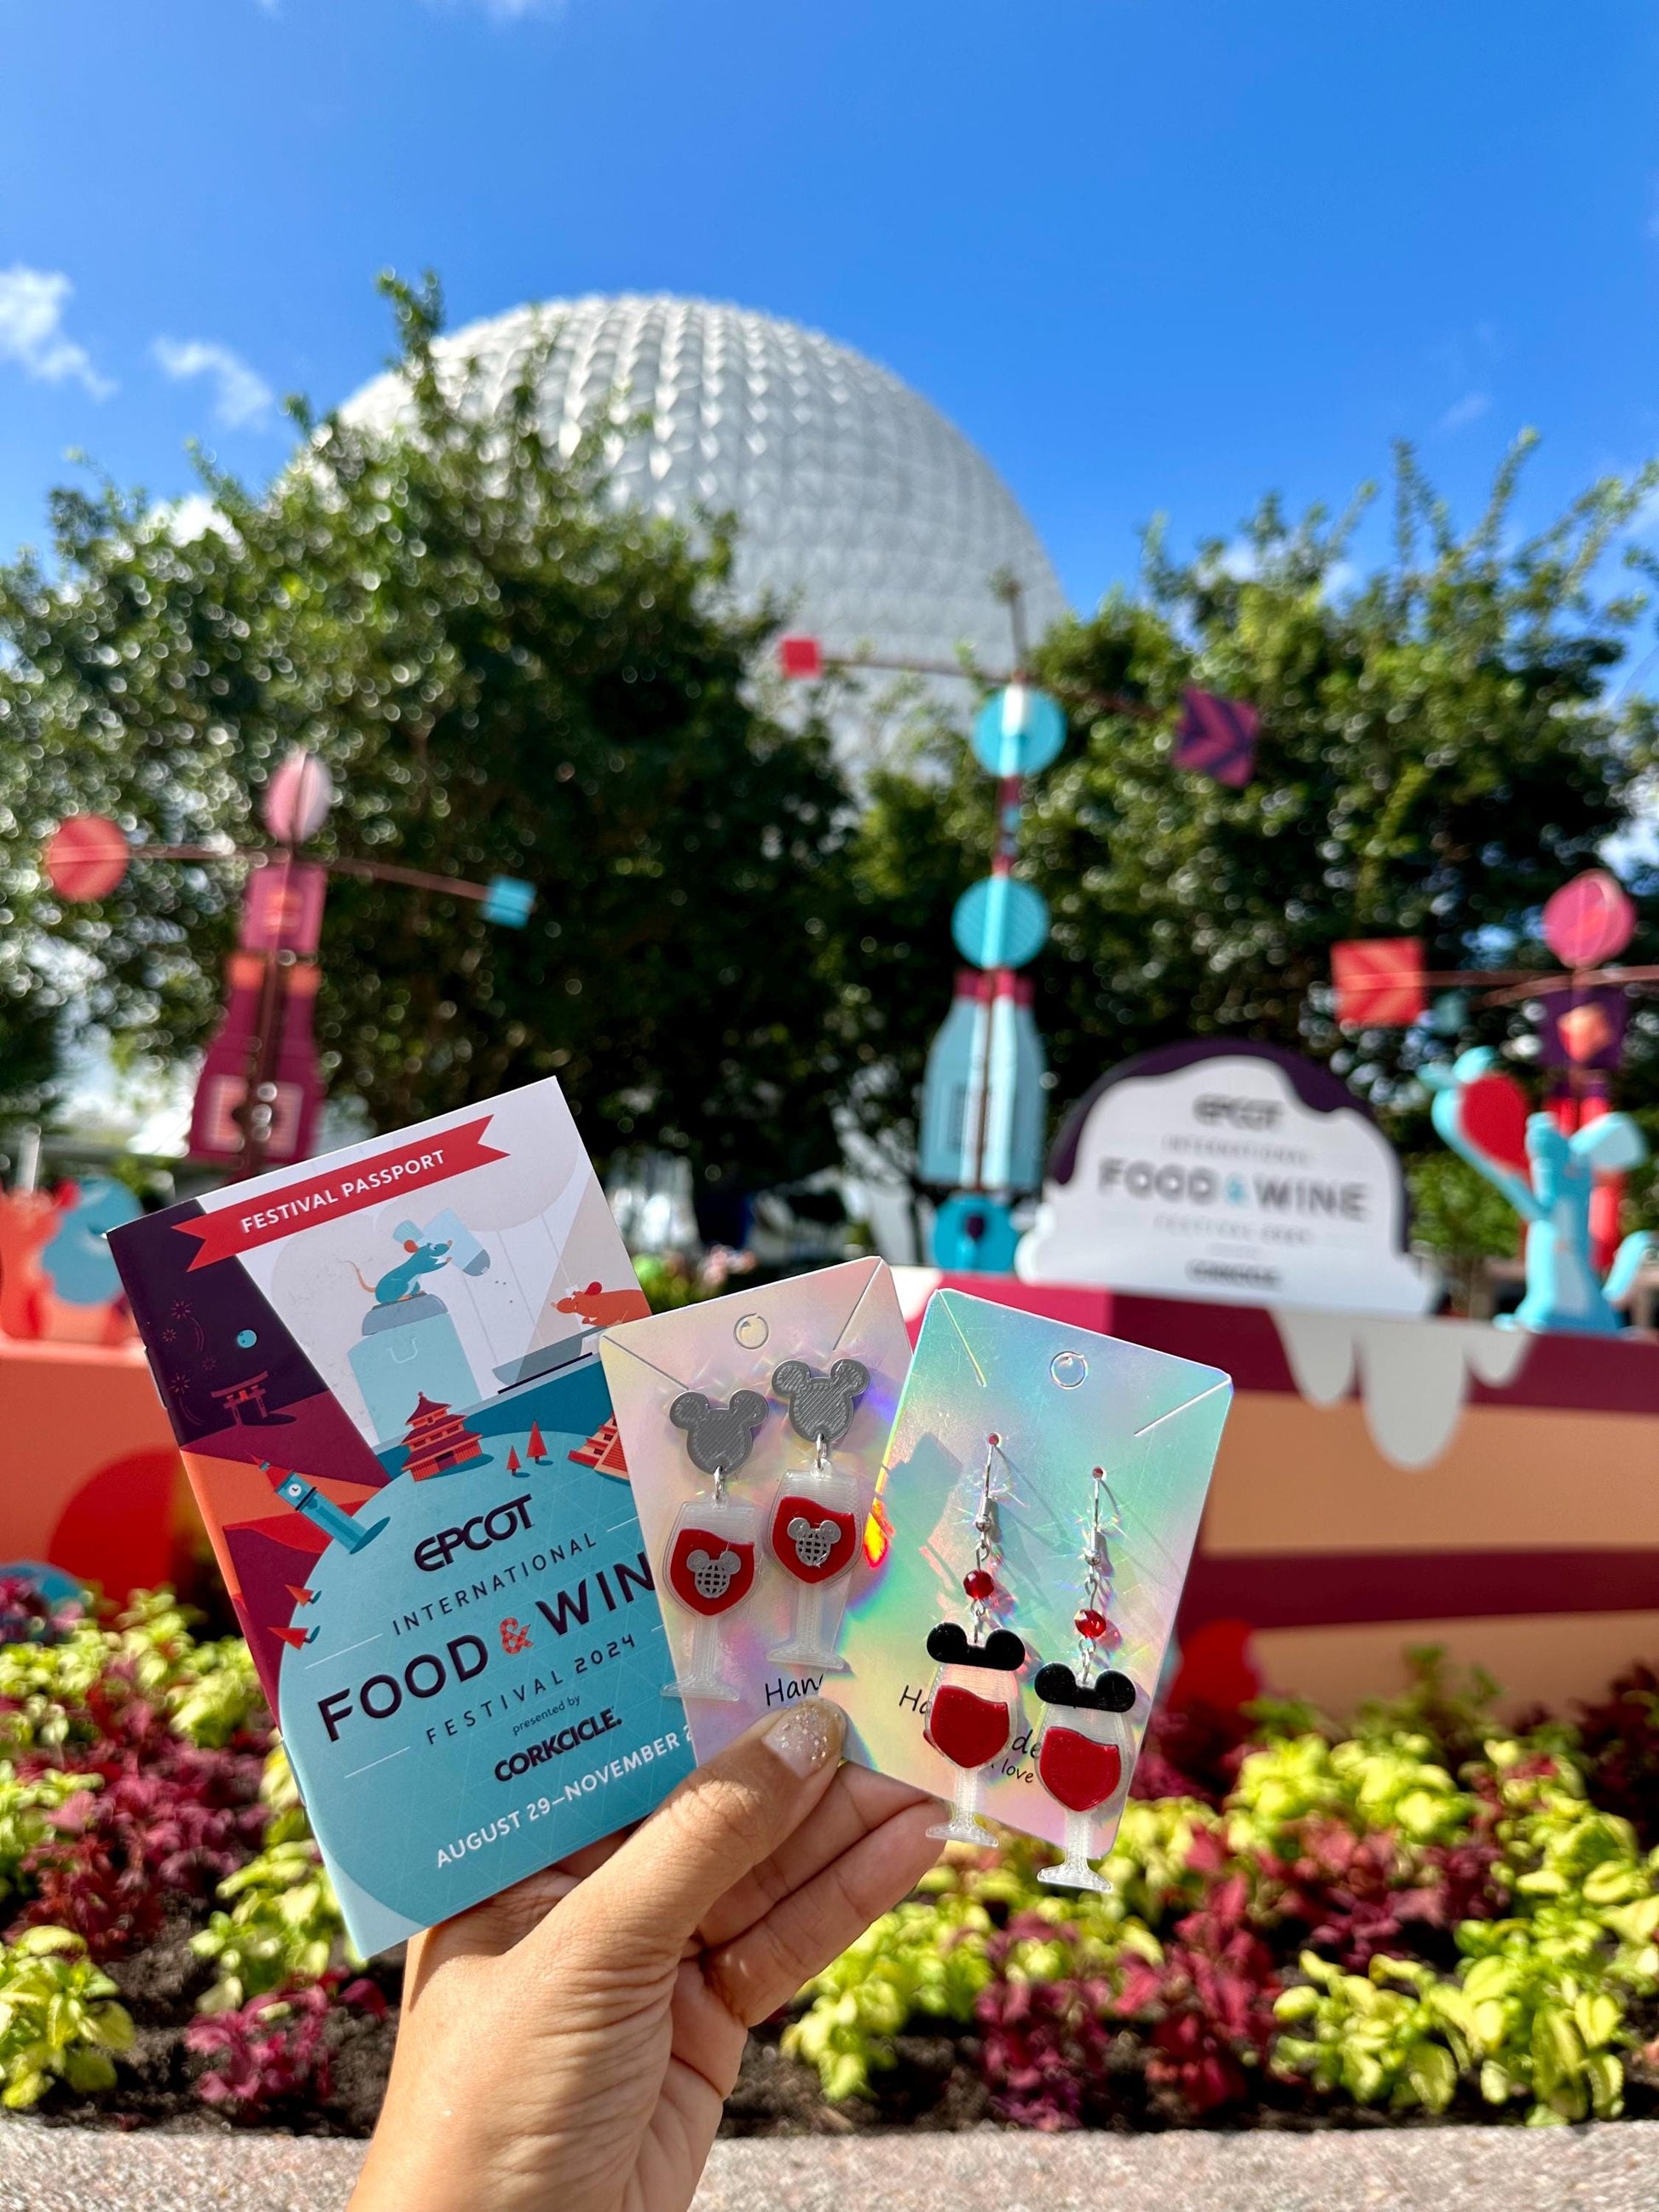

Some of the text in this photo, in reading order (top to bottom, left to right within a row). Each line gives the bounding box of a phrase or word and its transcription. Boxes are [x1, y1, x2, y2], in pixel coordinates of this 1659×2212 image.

[240, 1149, 444, 1233] FESTIVAL PASSPORT
[1098, 1156, 1218, 1206] FOOD
[1252, 1175, 1367, 1222] WINE
[413, 1493, 533, 1572] EPCOT
[392, 1533, 597, 1636] INTERNATIONAL
[317, 1551, 656, 1742] FOOD & WIN
[426, 1633, 635, 1745] FESTIVAL 2024
[512, 1695, 581, 1736] presented by
[1001, 1758, 1034, 1783] love
[436, 1810, 522, 1869] AUGUST
